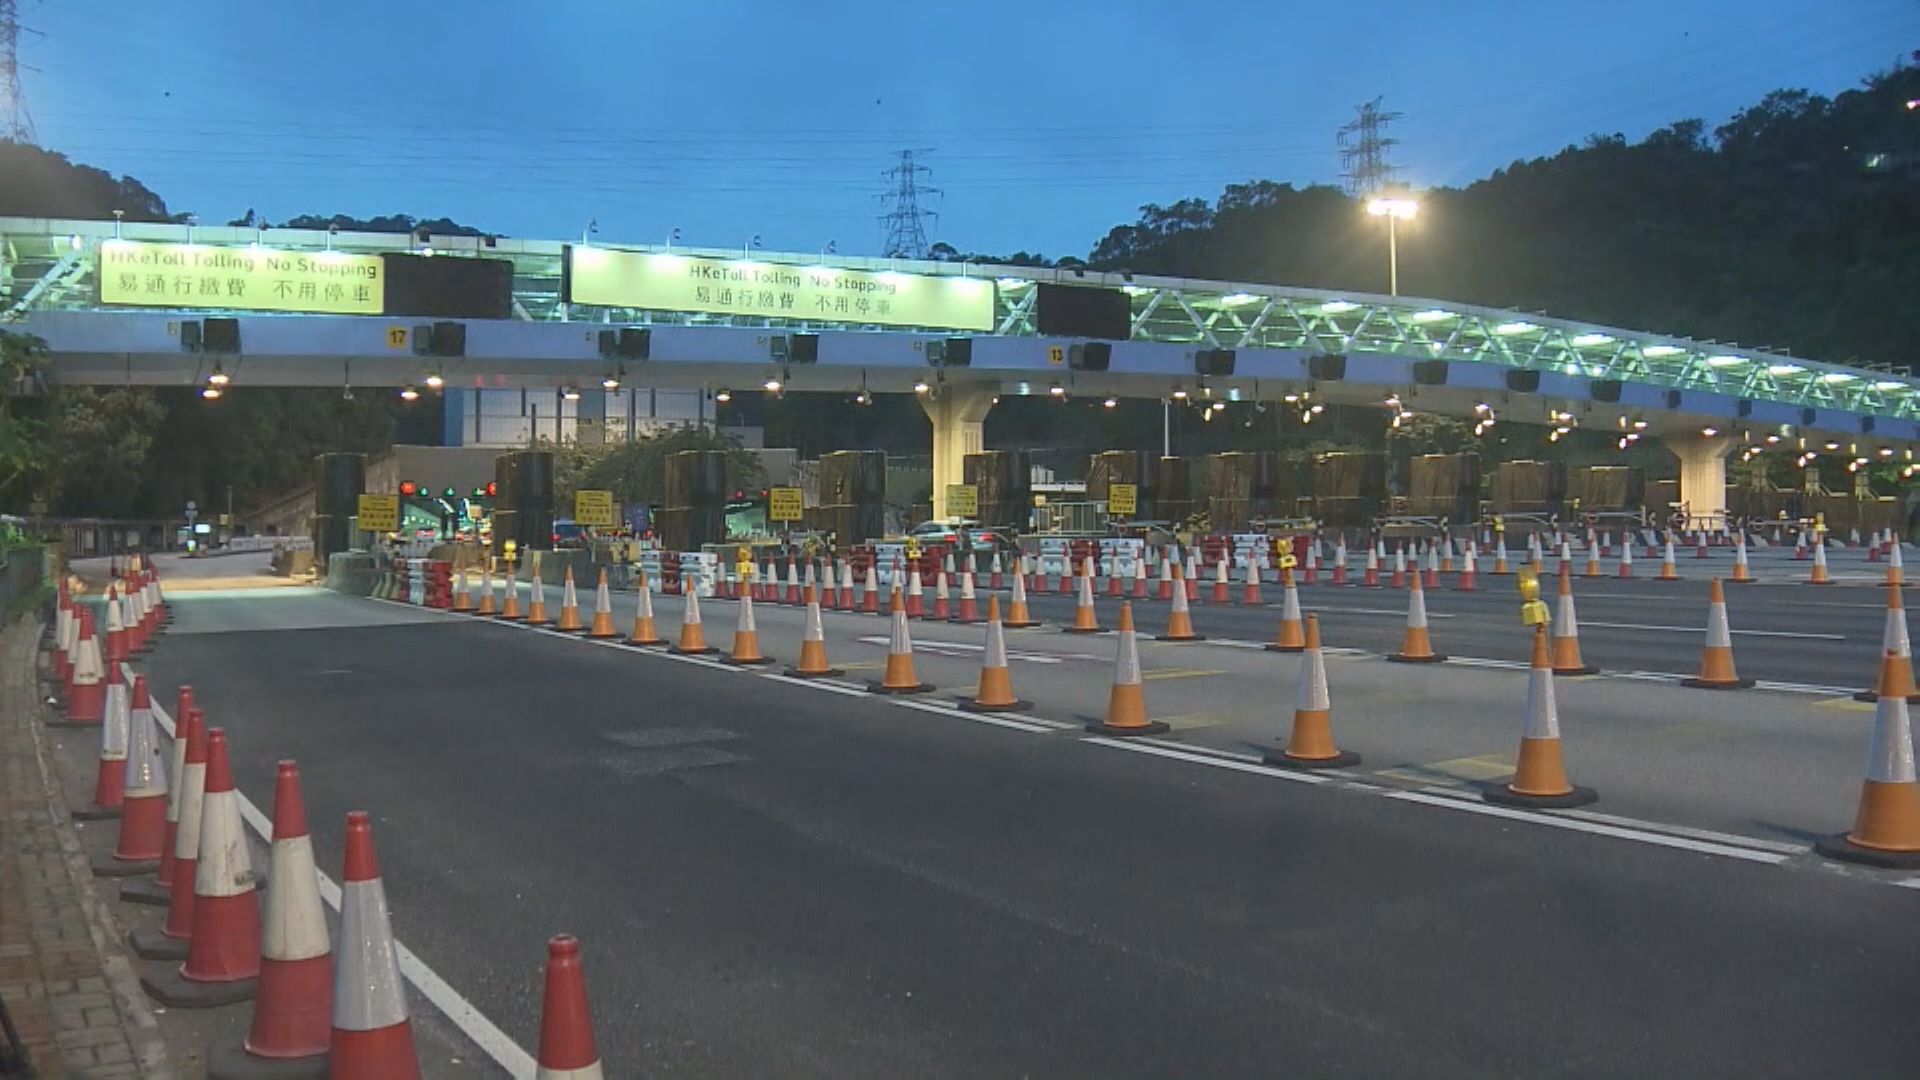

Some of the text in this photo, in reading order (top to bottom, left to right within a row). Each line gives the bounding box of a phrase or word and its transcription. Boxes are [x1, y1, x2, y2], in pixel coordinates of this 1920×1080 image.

[111, 250, 377, 279] HKeToll Tolling No Stopping
[273, 279, 371, 302] 不用停車
[754, 269, 800, 288] Tolling
[809, 274, 830, 287] No
[835, 276, 896, 296] Stopping
[389, 329, 406, 344] 17
[1050, 348, 1064, 361] 13
